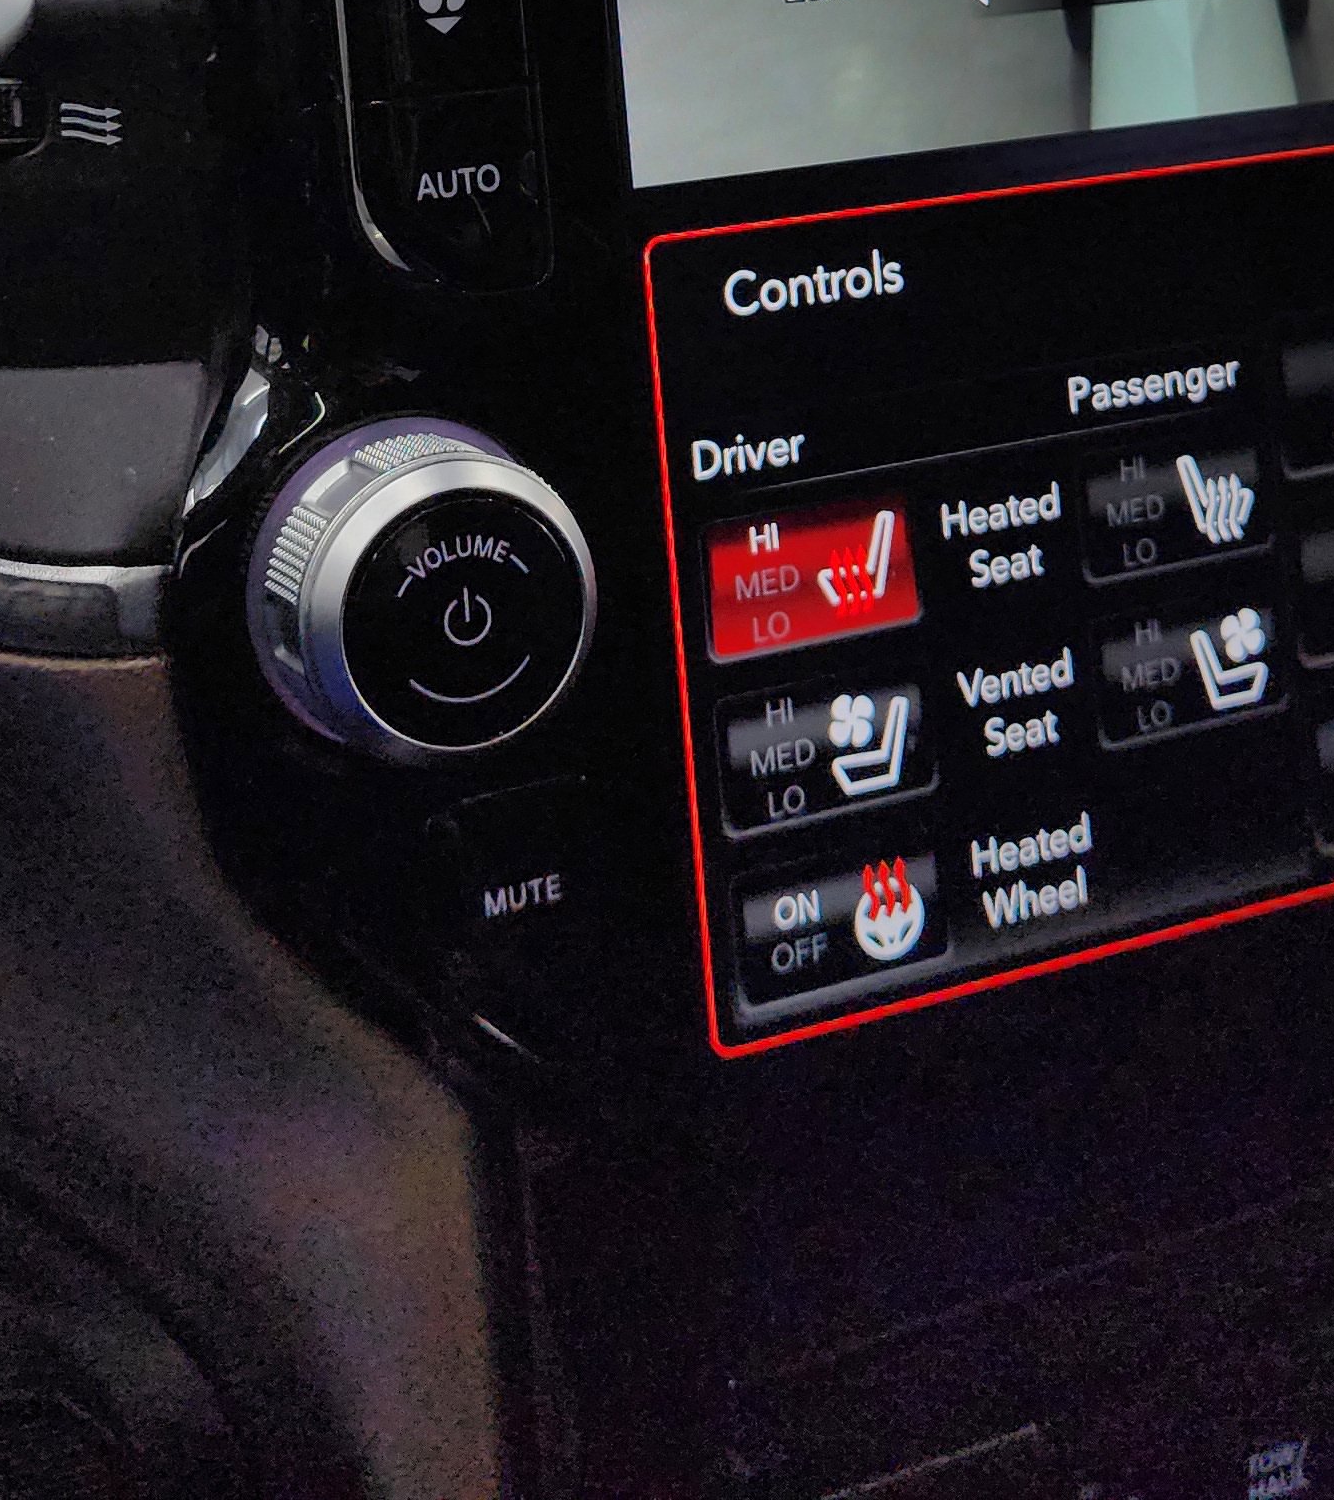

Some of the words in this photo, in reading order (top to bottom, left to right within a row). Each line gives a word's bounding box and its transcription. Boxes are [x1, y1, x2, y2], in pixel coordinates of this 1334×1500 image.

[417, 163, 501, 201] AUTO
[723, 248, 905, 317] Controls
[1067, 360, 1241, 415] Passenger
[691, 434, 805, 481] Driver
[1119, 455, 1147, 483] HI
[941, 481, 1062, 539] Heated
[1106, 494, 1165, 527] MED
[405, 534, 510, 581] VOLUME
[748, 522, 780, 555] HI
[1122, 537, 1158, 568] LO
[734, 565, 800, 601] MED
[969, 544, 1045, 588] Seat
[752, 611, 791, 644] LO
[957, 646, 1075, 707] Vented
[1121, 657, 1181, 693] MED
[765, 697, 795, 728] HI
[1136, 700, 1173, 731] LO
[984, 710, 1060, 758] Seat
[750, 737, 816, 777] MED
[767, 785, 806, 820] LO
[971, 810, 1093, 879] Heated
[484, 873, 563, 918] MUTE
[773, 889, 821, 931] ON
[982, 864, 1088, 928] Wheel
[771, 931, 828, 973] OFF
